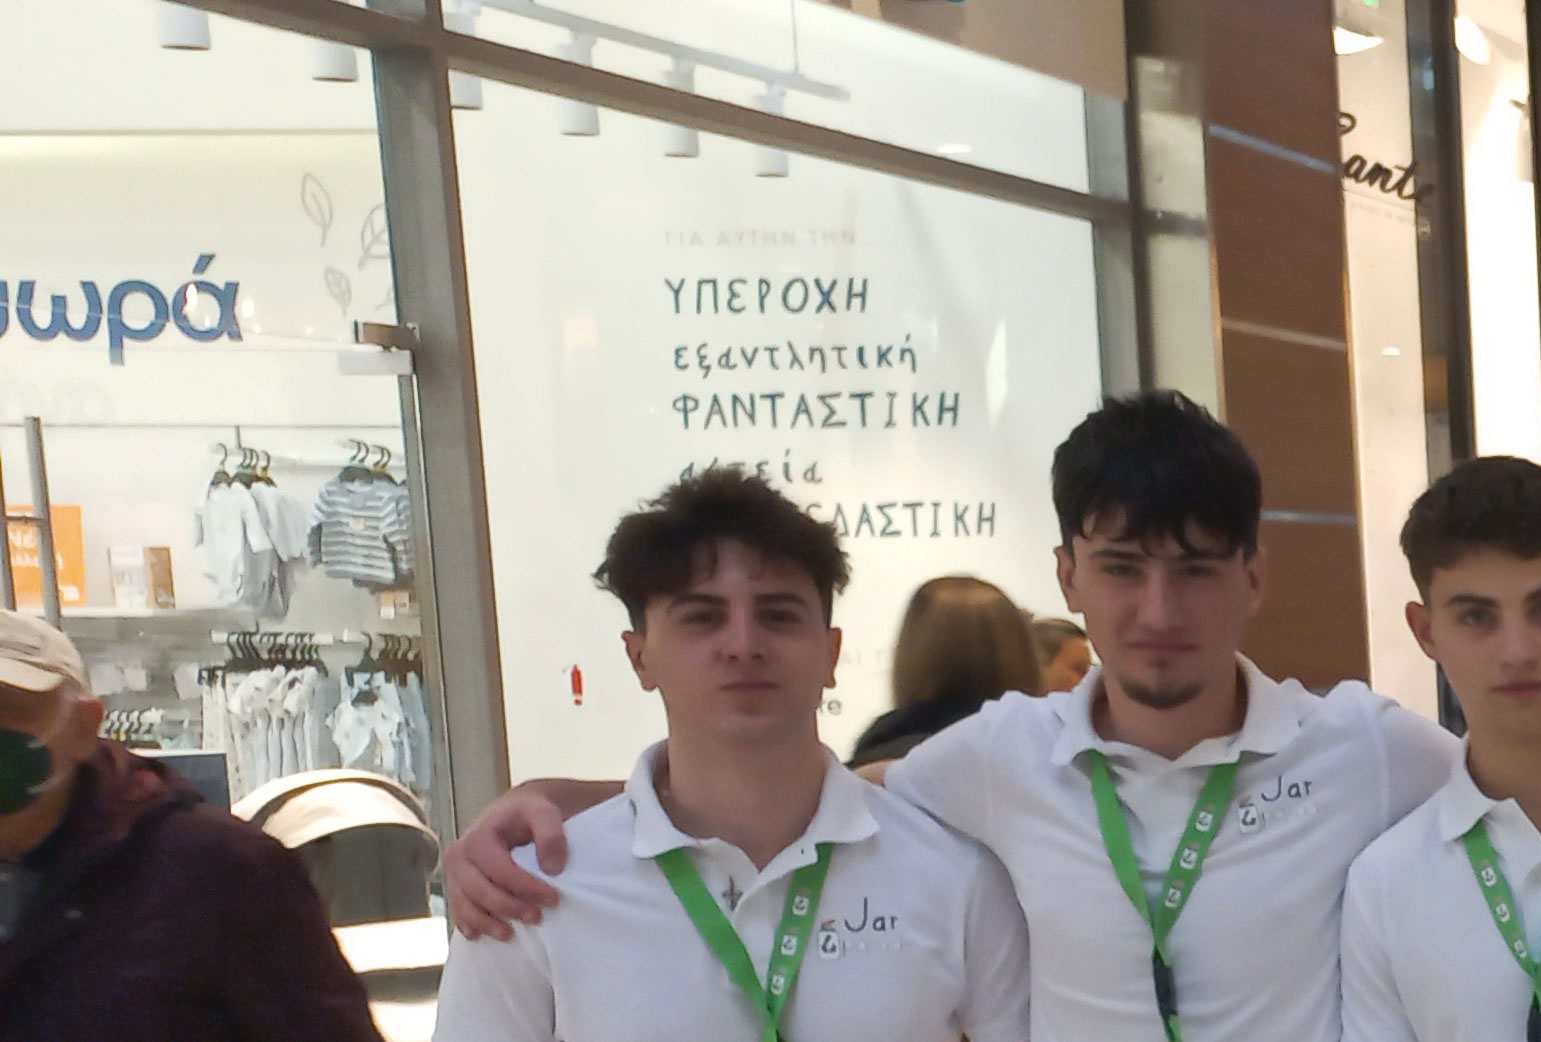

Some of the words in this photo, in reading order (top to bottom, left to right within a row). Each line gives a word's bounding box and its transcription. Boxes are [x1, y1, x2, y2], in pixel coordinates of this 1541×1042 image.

[664, 277, 868, 315] ΥΠΕΡΟΧΗ
[674, 333, 917, 379] εξαντλητική
[672, 391, 960, 430] ΦΑΝΤΑΣΤΙΚΗ
[1261, 775, 1312, 802] Jar
[843, 896, 898, 933] Jar
